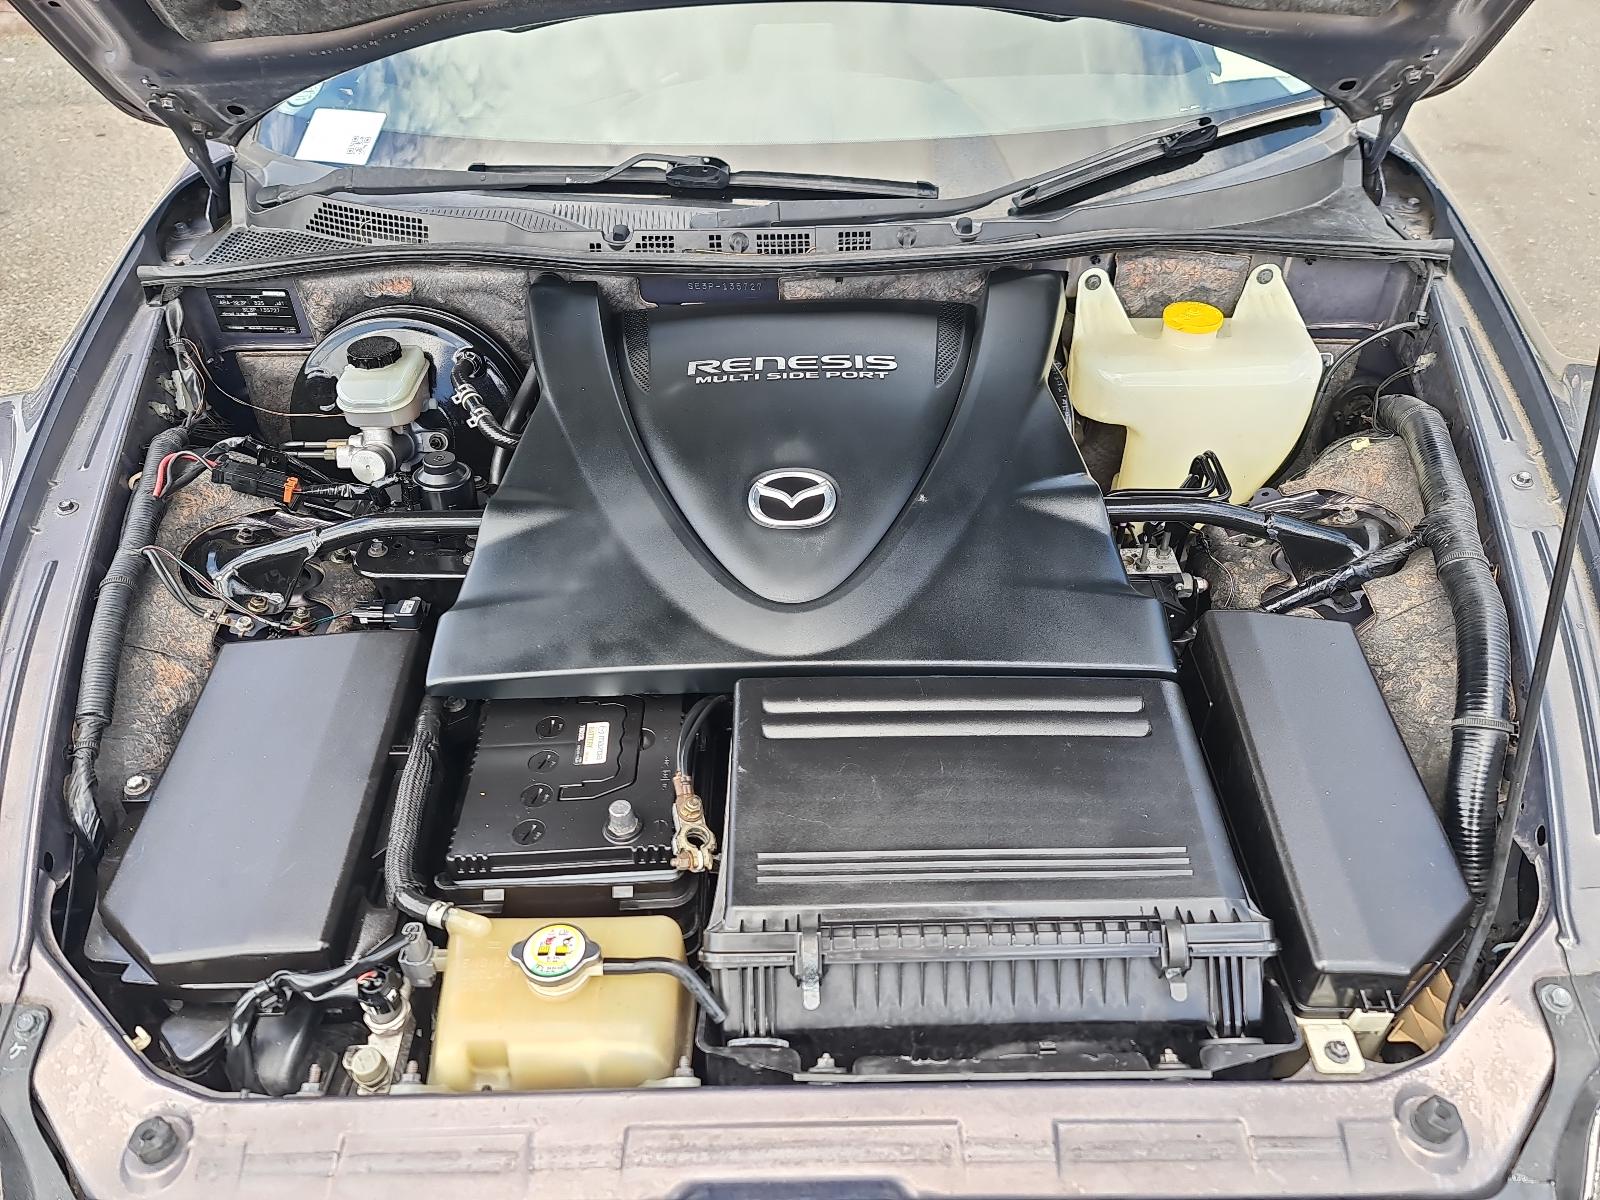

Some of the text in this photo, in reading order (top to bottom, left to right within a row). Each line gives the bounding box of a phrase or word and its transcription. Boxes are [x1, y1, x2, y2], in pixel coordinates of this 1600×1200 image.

[687, 354, 898, 375] RENESIS
[695, 371, 889, 384] MULTI SIDE PORT
[587, 726, 595, 748] BATTERY
